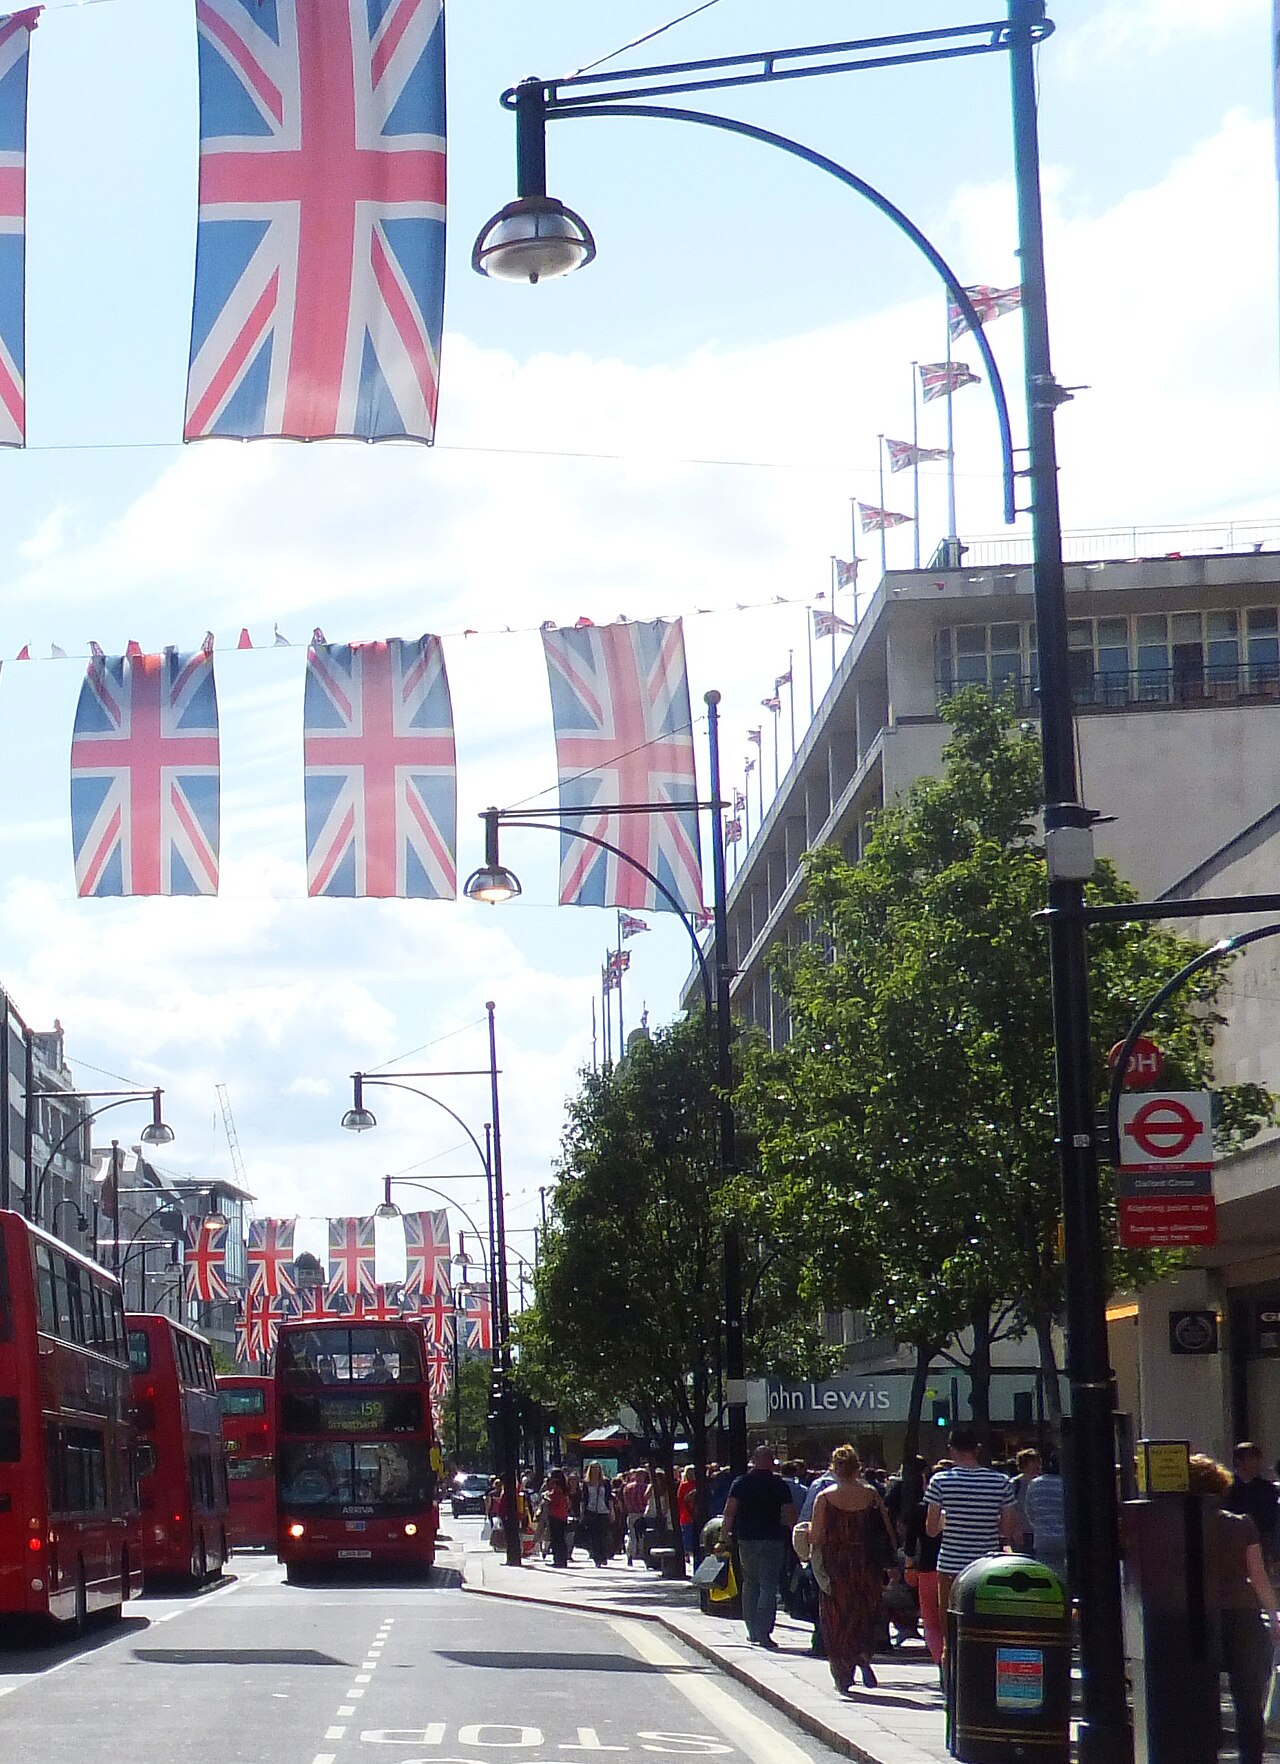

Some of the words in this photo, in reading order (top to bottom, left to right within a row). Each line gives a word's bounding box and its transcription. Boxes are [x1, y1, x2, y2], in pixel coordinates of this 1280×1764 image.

[361, 1402, 382, 1416] 159
[810, 1382, 891, 1410] Lewis
[360, 1722, 735, 1755] STOP
